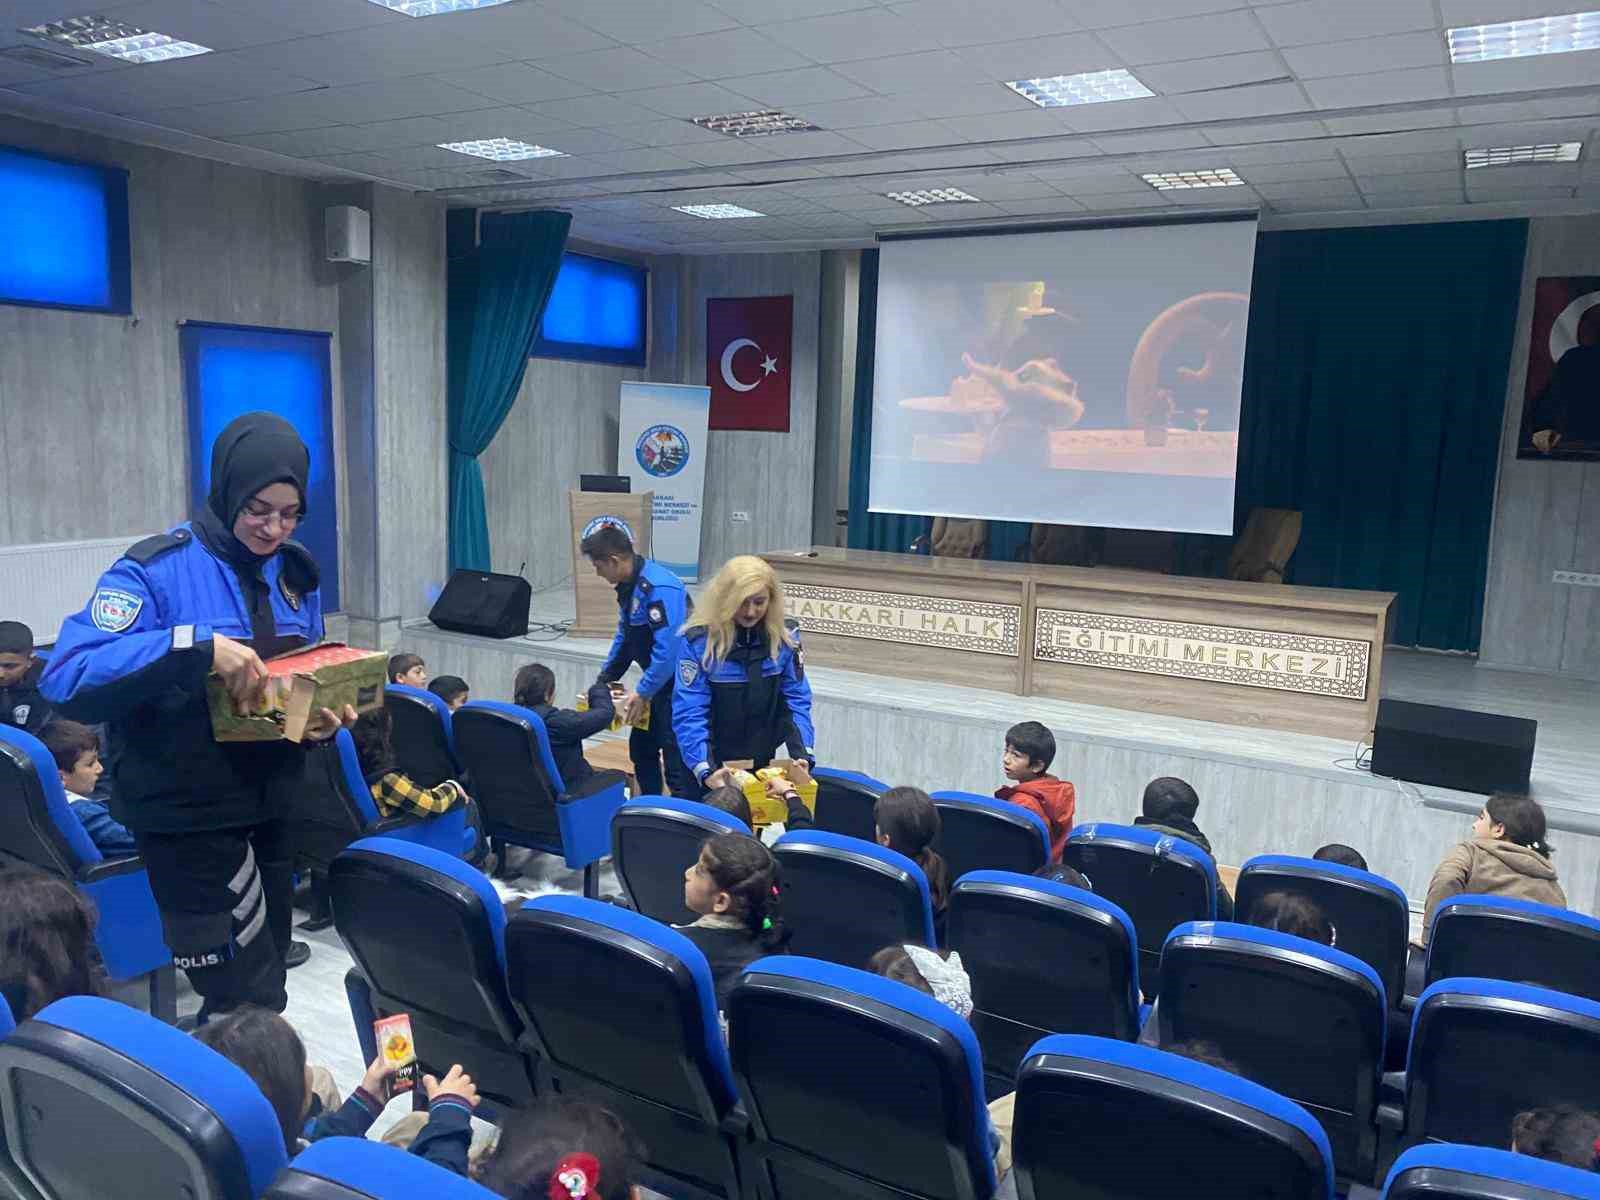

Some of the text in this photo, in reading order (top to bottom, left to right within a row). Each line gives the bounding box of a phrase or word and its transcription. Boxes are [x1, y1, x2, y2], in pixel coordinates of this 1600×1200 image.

[921, 608, 1001, 638] HALK
[1055, 629, 1343, 678] EĞİTİMİ MERKEZİ
